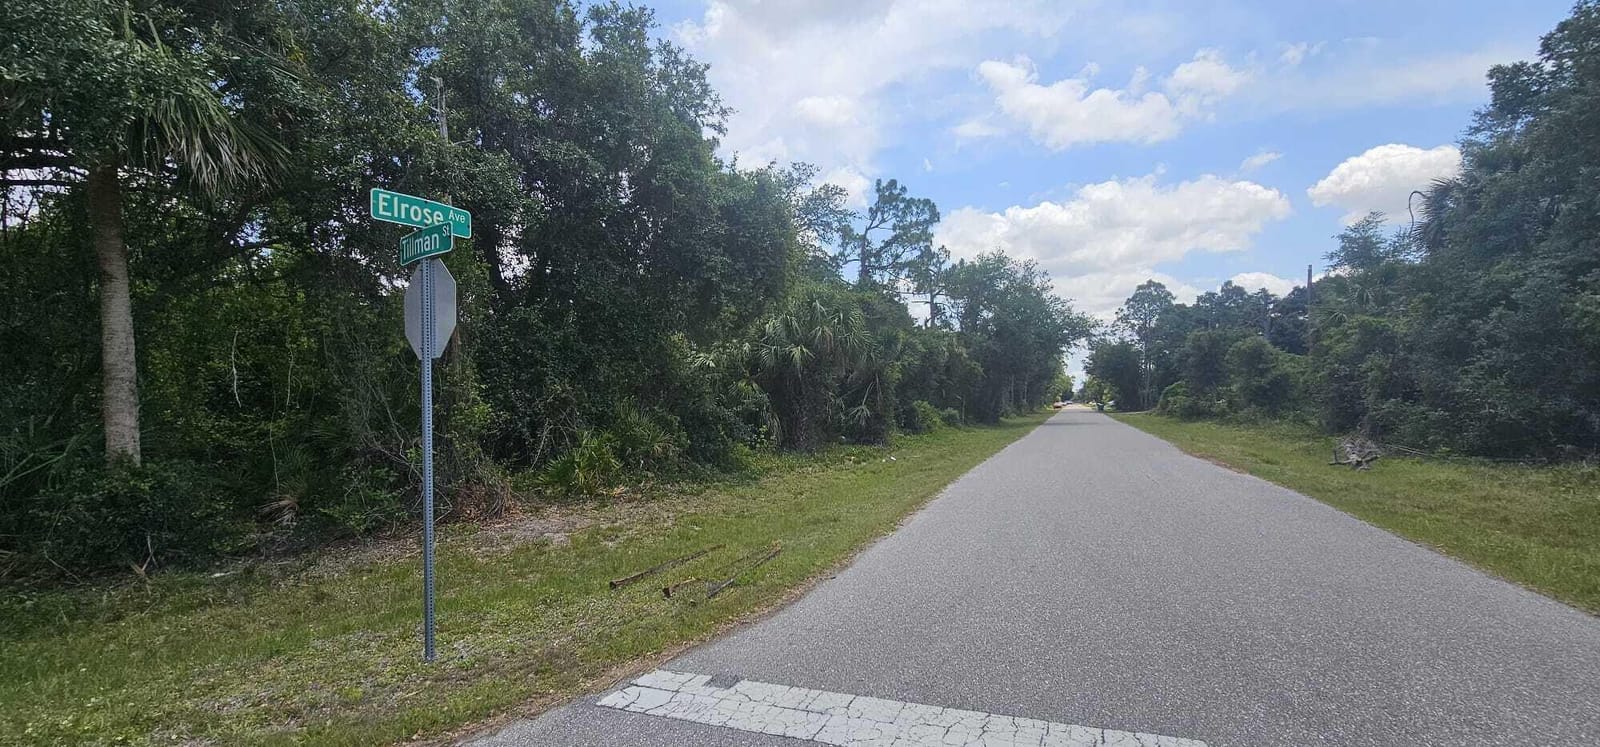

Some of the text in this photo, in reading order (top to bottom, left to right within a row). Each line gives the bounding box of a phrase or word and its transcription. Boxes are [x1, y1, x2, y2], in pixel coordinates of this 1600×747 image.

[378, 193, 466, 225] Elrose Ave
[402, 224, 450, 260] Tillman St
